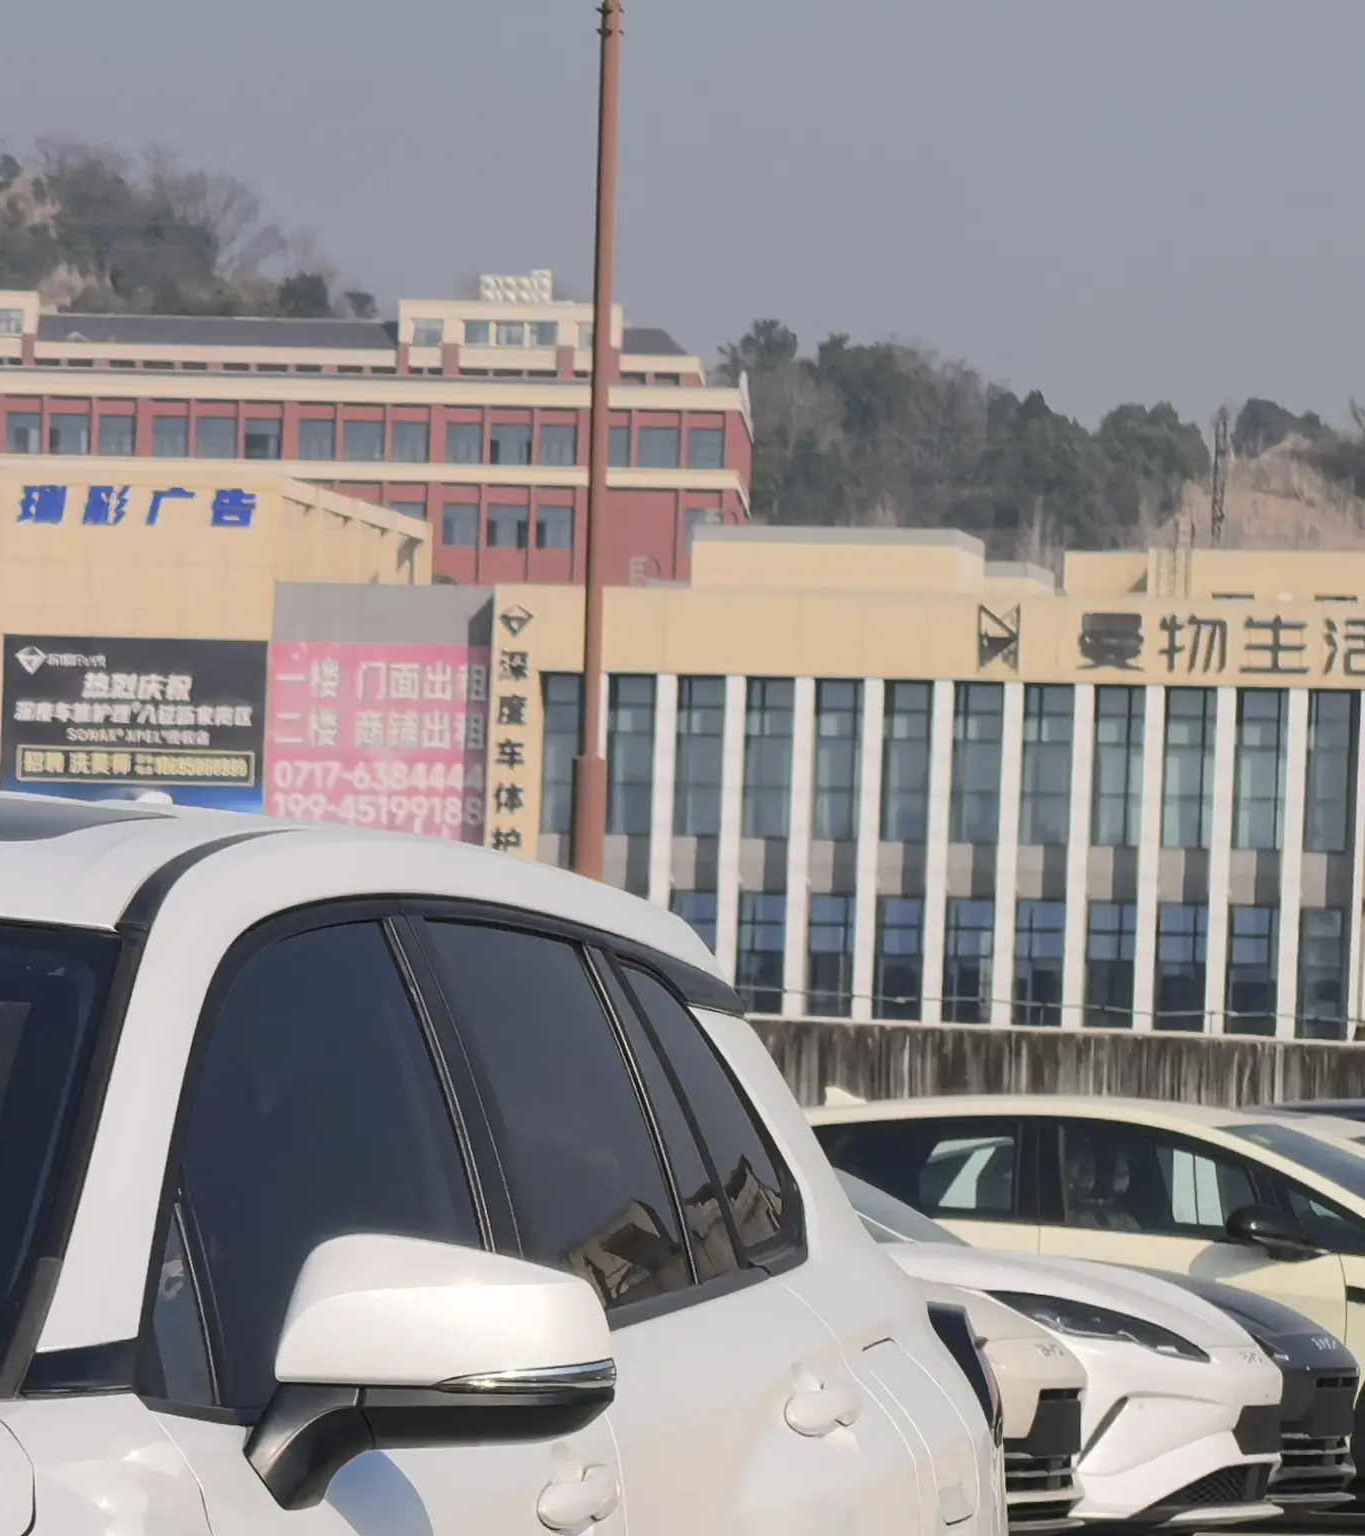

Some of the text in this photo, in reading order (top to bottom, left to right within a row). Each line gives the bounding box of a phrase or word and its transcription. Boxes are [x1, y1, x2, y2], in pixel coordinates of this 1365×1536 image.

[275, 657, 487, 701] 一楼 门面出租
